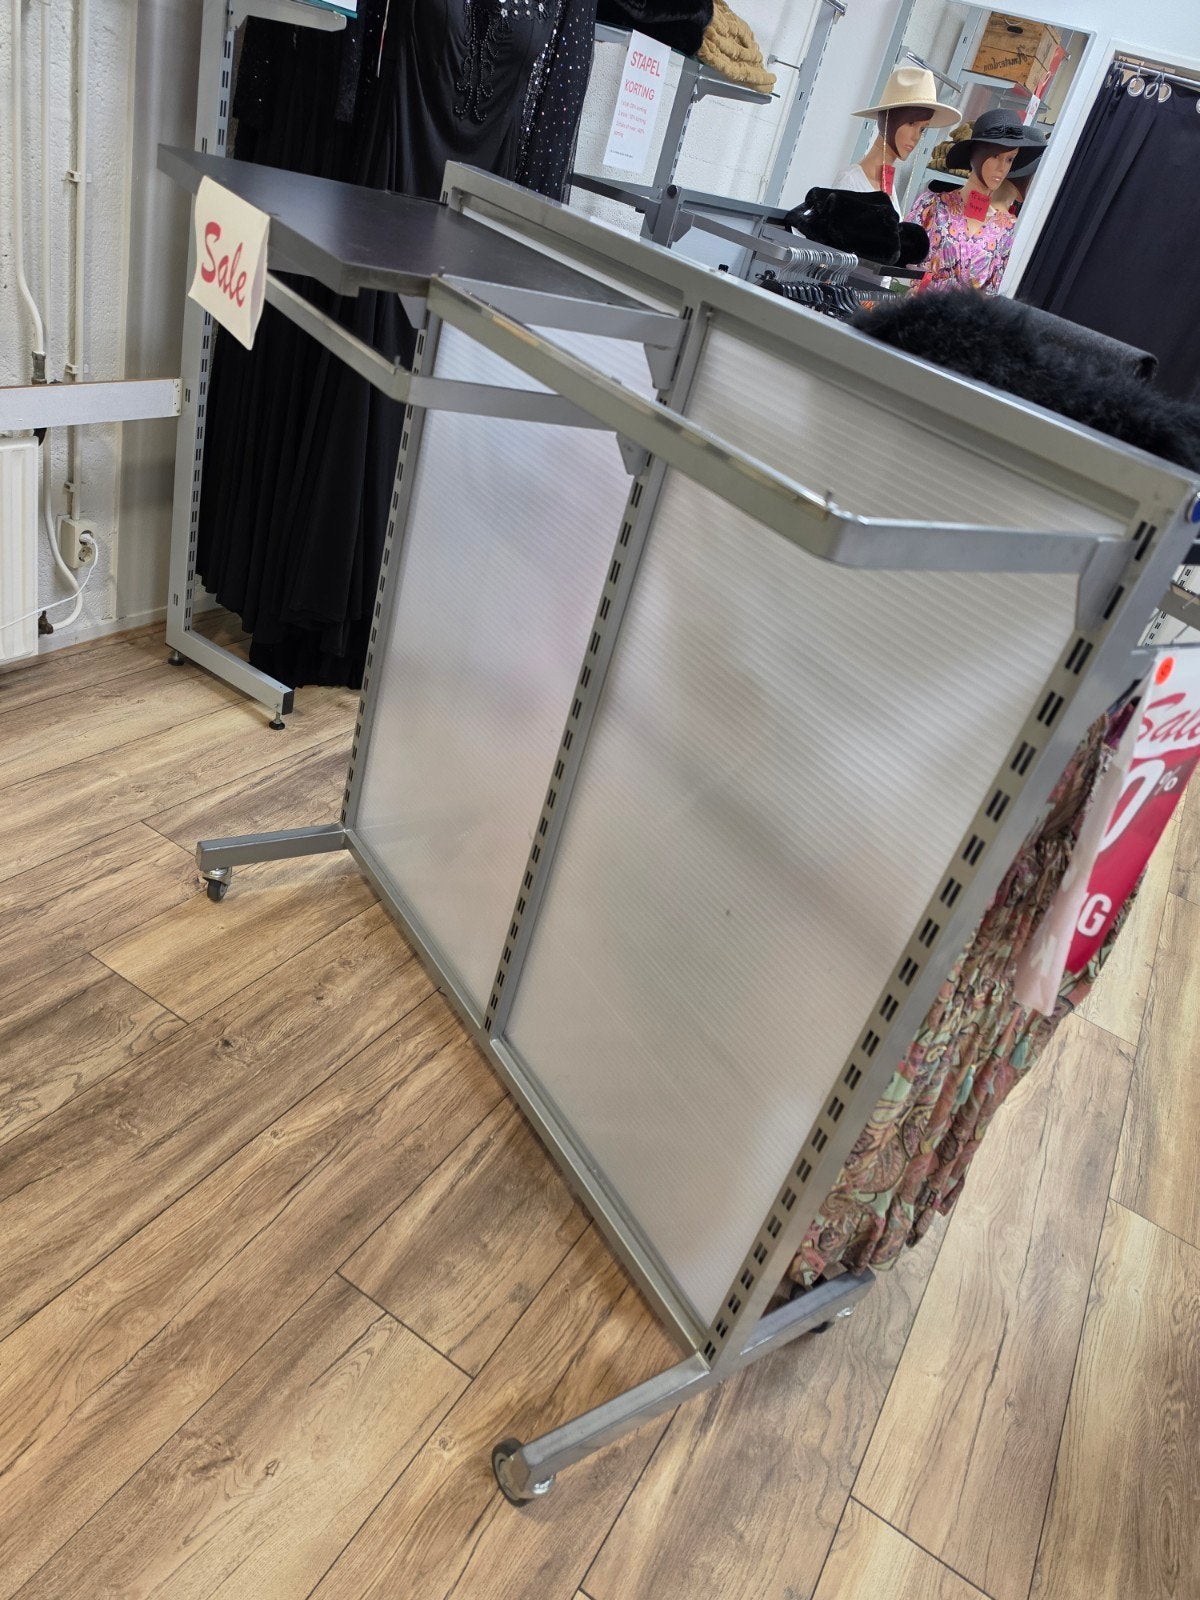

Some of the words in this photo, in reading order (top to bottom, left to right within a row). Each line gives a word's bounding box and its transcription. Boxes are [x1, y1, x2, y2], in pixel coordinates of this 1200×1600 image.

[630, 50, 661, 77] STAPEL
[624, 80, 655, 101] KORTING
[200, 221, 248, 309] Sale
